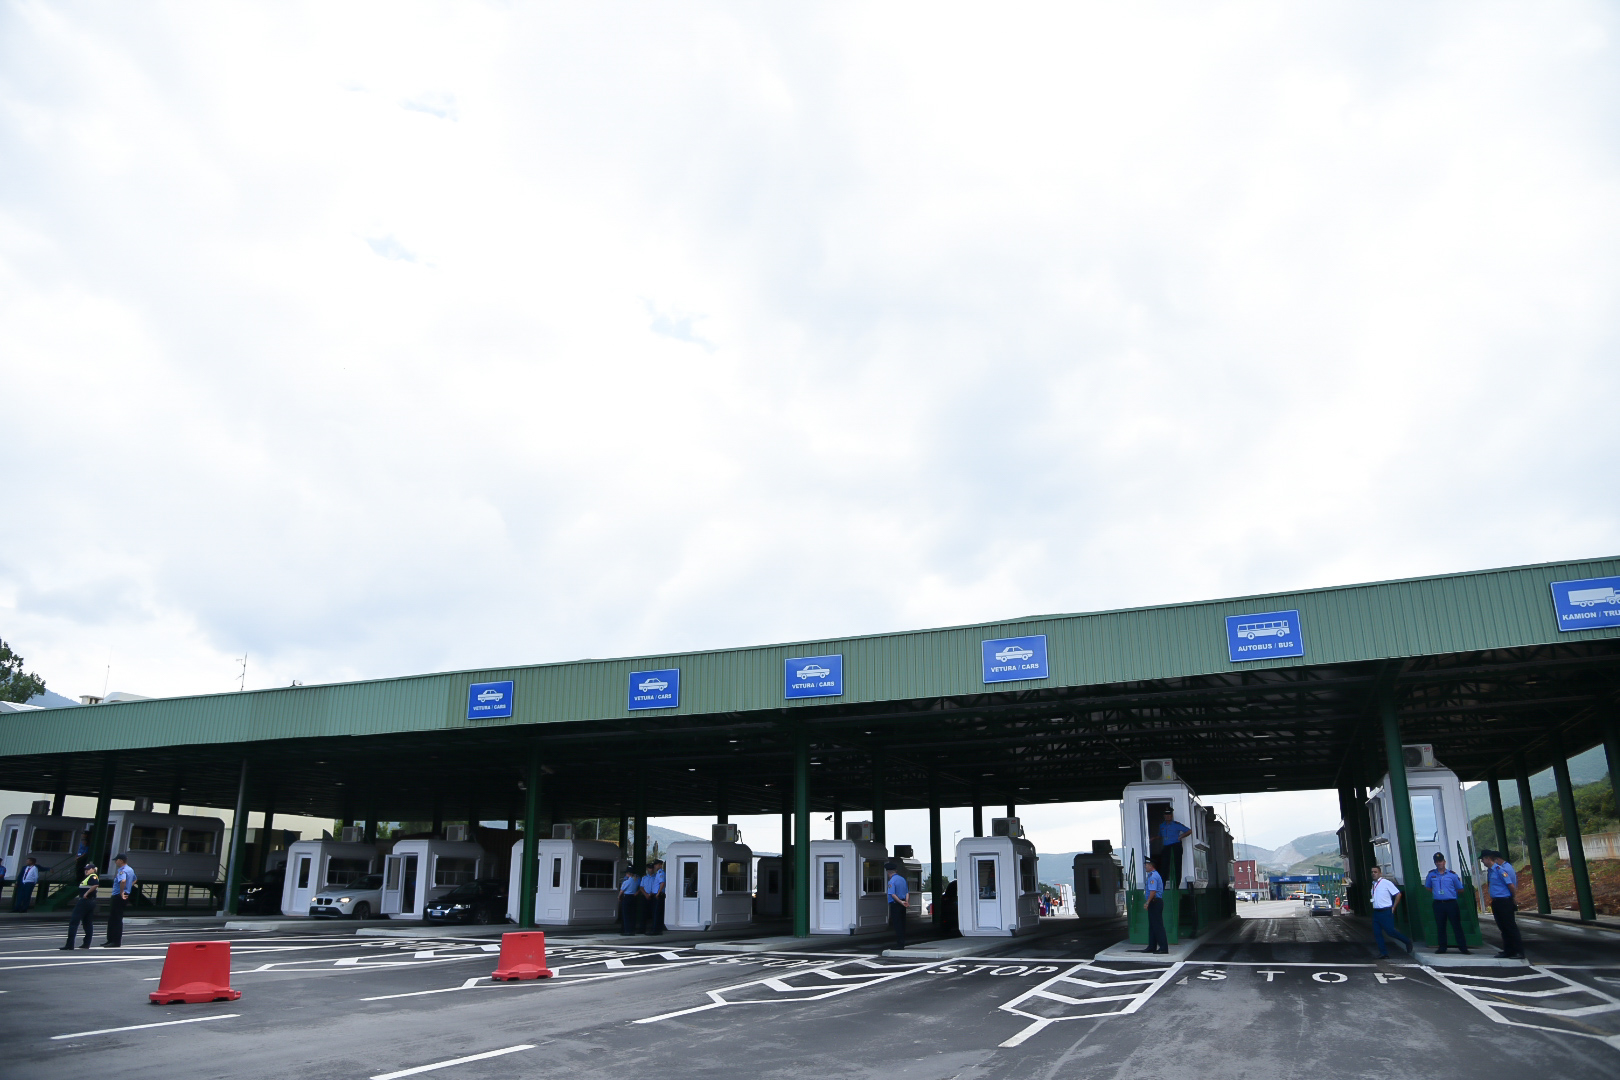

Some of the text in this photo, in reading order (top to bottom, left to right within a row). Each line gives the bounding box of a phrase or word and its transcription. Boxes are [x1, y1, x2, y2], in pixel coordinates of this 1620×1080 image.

[1562, 611, 1597, 621] KAMION
[1237, 643, 1273, 652] AUTOBUS
[990, 665, 1017, 673] VETURA
[709, 956, 835, 968] STOP
[926, 964, 1059, 977] STOP
[1196, 969, 1406, 984] STOP
